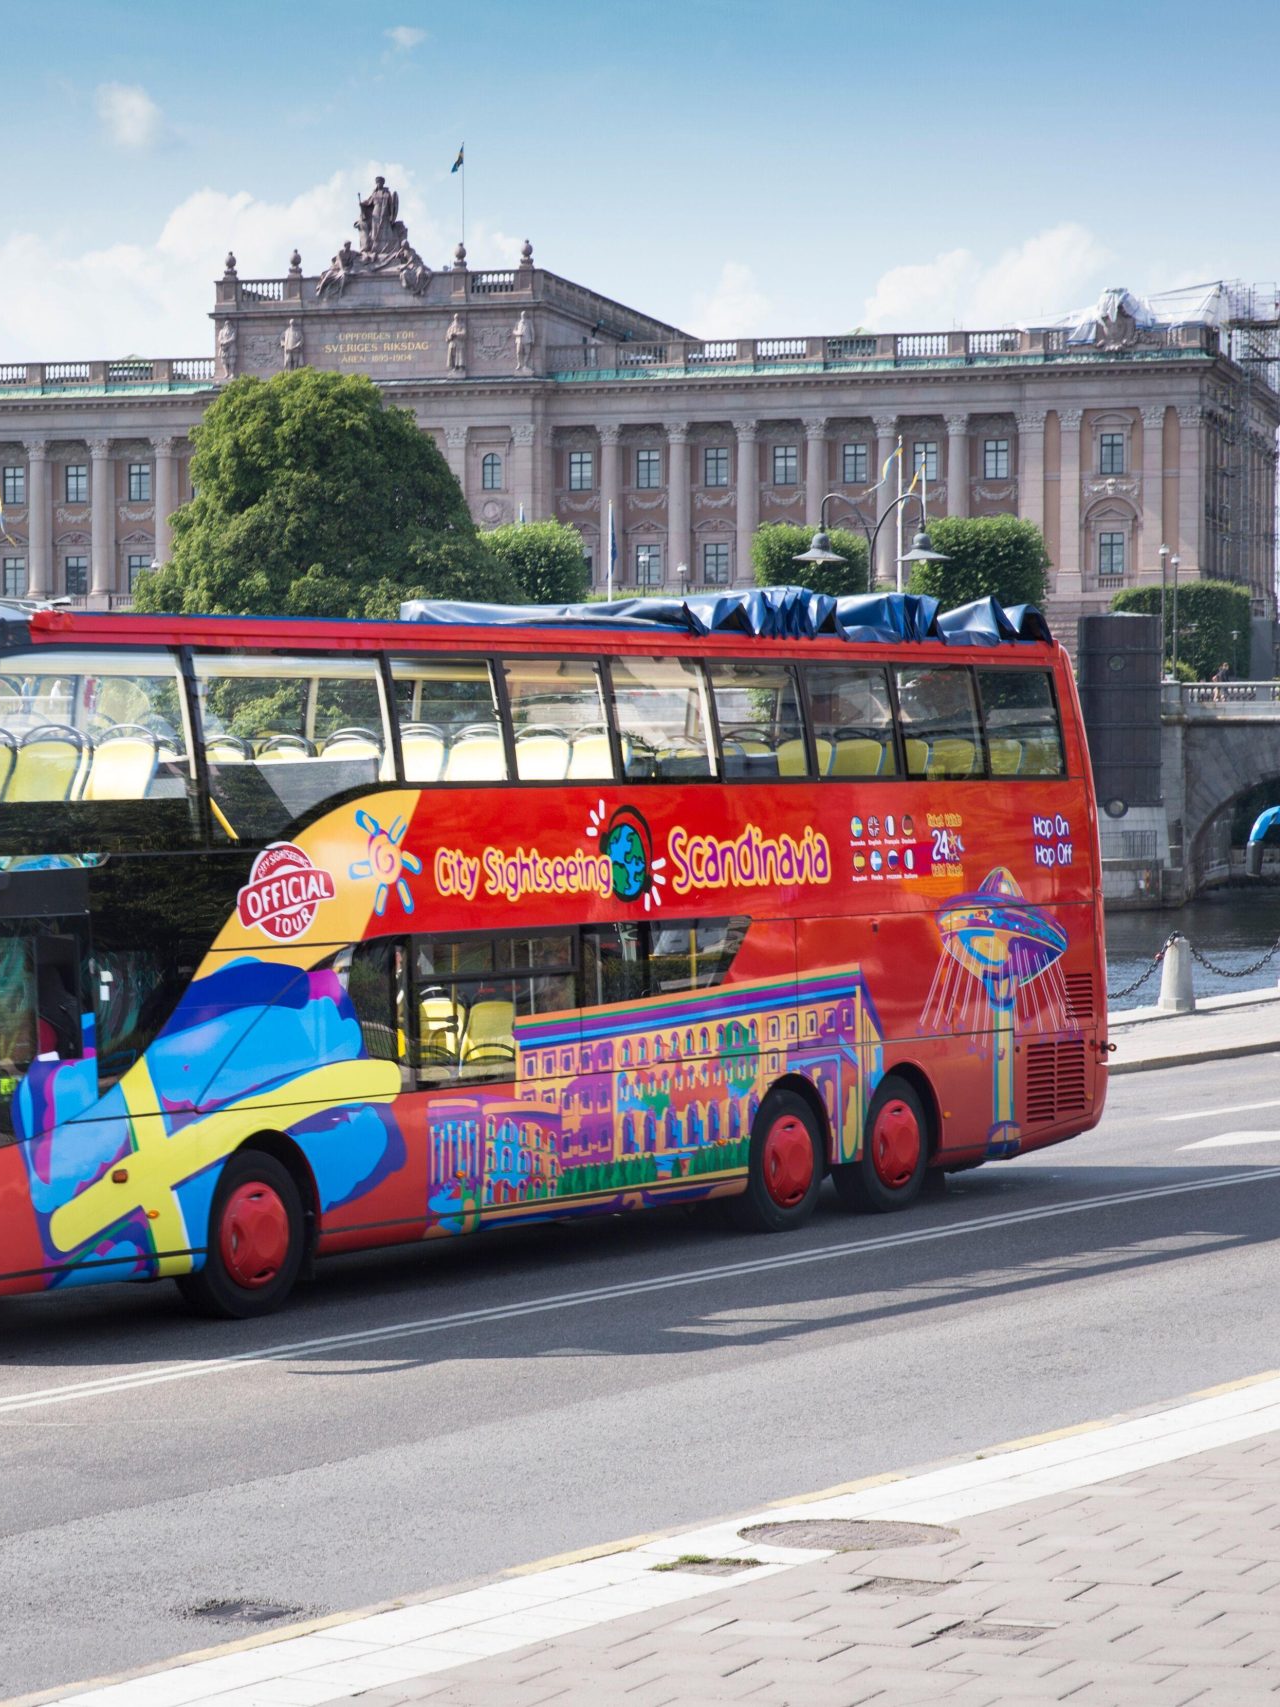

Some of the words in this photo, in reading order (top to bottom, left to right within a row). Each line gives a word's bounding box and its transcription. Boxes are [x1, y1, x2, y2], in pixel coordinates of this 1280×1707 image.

[324, 343, 378, 353] SVERIGES
[383, 341, 429, 352] RIKSDAG
[1033, 816, 1053, 839] Hop
[1055, 814, 1069, 836] On
[669, 824, 831, 893] Scandinavia
[1035, 845, 1055, 868] Hop
[1057, 842, 1073, 865] Off
[435, 848, 480, 899] City
[484, 848, 612, 901] Sightseeing
[246, 873, 331, 919] OFFICIAL
[274, 907, 313, 935] TOUR
